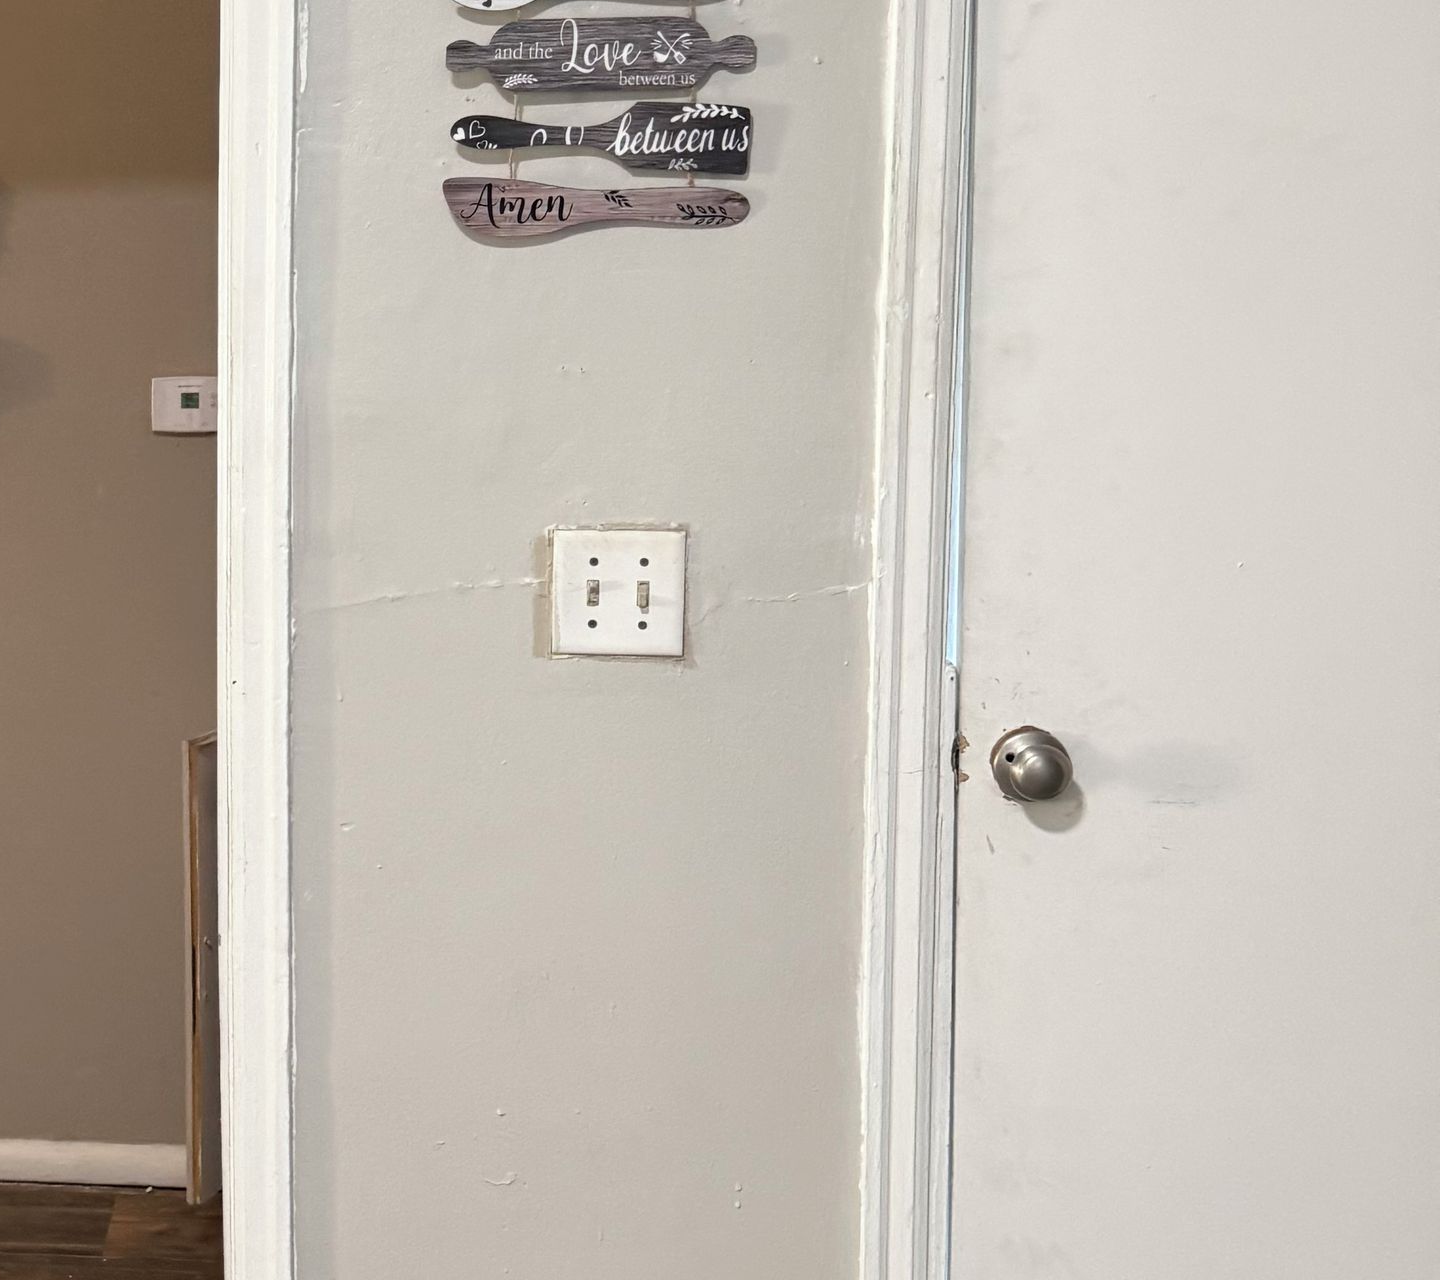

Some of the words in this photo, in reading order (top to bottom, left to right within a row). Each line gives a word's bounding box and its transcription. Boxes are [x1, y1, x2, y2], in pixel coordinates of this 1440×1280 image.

[494, 41, 523, 60] and
[529, 41, 553, 60] the
[560, 18, 642, 73] Love
[618, 70, 676, 87] between
[680, 73, 696, 86] us
[605, 113, 715, 156] between
[721, 125, 749, 152] us
[461, 183, 574, 229] Amen
